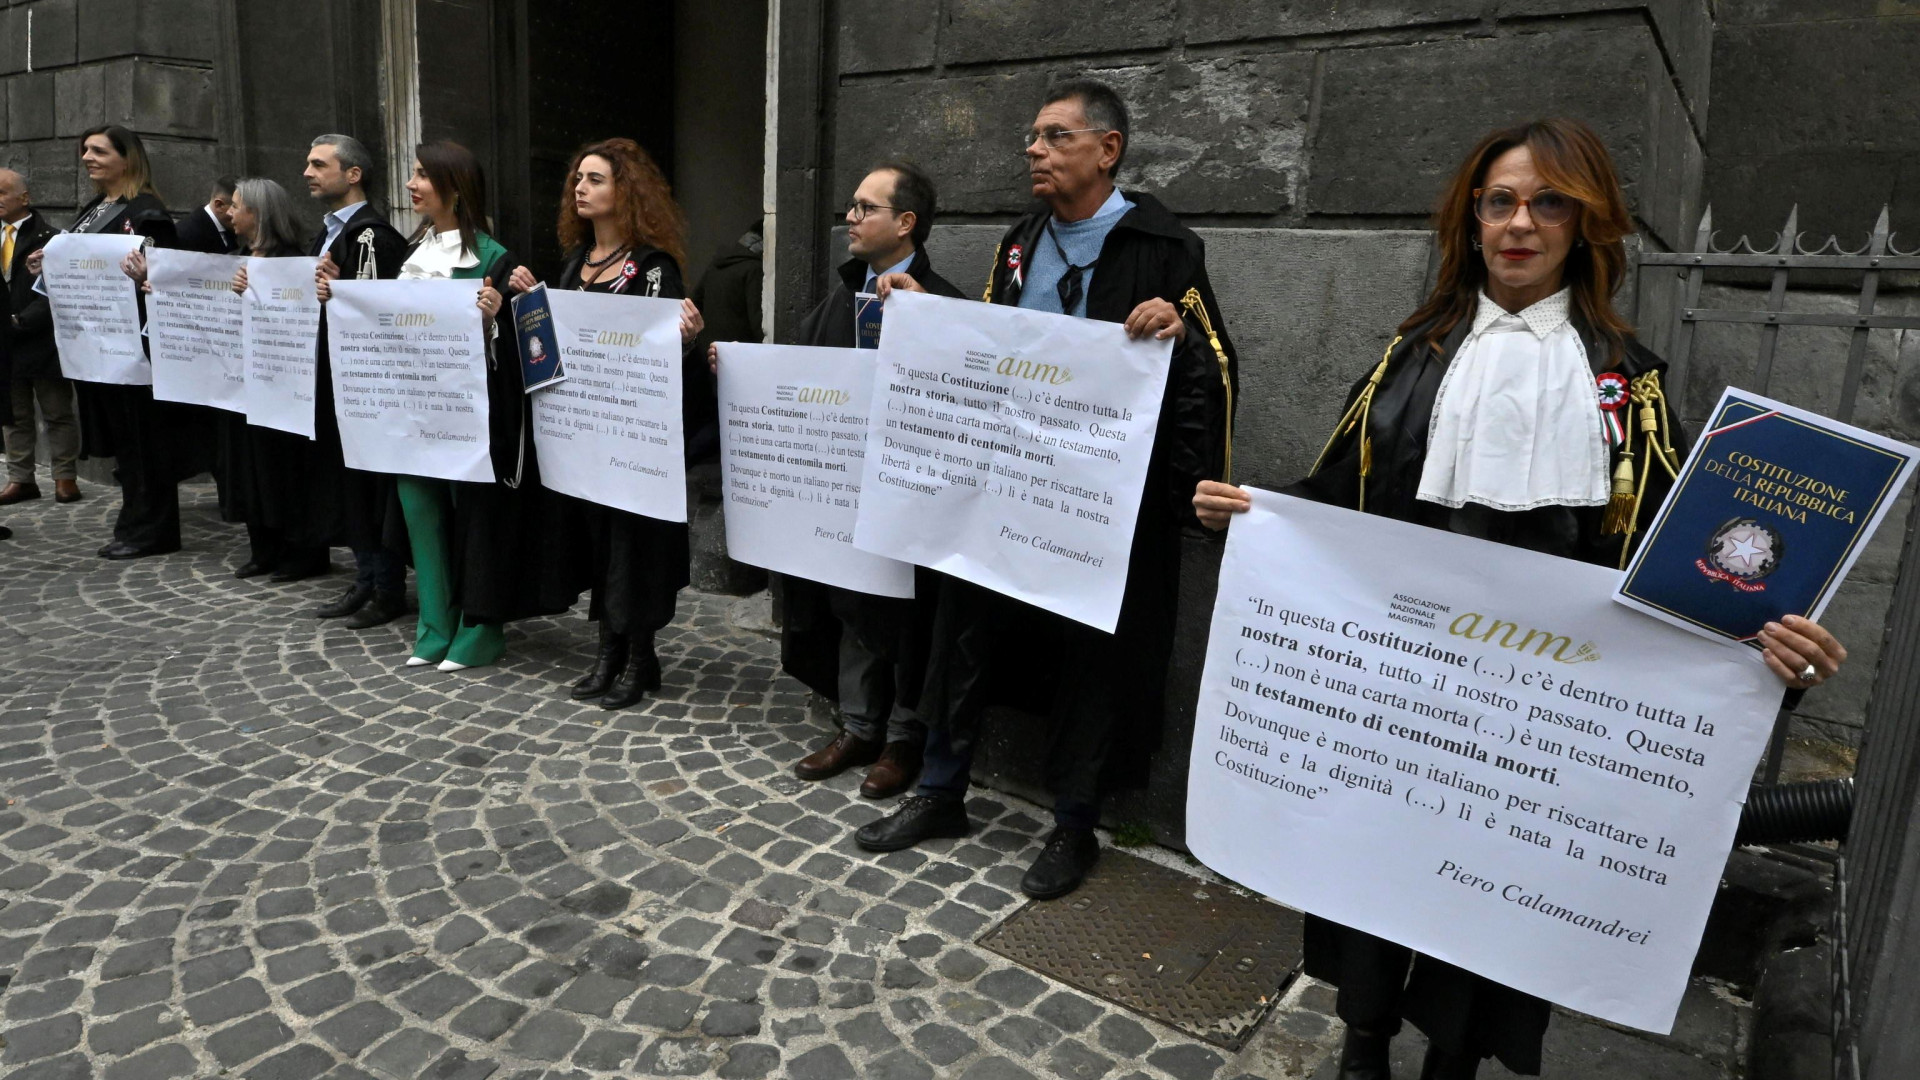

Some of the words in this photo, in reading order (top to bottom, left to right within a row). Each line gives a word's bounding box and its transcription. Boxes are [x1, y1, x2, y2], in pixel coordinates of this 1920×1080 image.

[349, 370, 384, 379] testamento
[566, 346, 606, 360] Costituzione
[996, 357, 1059, 385] anm
[587, 393, 619, 405] centomila
[738, 405, 760, 416] questa
[761, 405, 808, 420] Costituzione
[839, 412, 864, 426] dentro
[798, 387, 841, 406] anm
[889, 383, 921, 397] nostra
[925, 390, 959, 405] storia,
[962, 396, 988, 411] tutto
[992, 400, 1001, 413] il
[1004, 406, 1036, 421] nostro
[1039, 415, 1082, 432] passato.
[1088, 422, 1127, 442] Questa
[907, 368, 939, 382] questa
[941, 372, 1010, 396] Costituzione
[1053, 395, 1090, 413] dentro
[1092, 404, 1119, 420] tutta
[1121, 407, 1133, 422] la
[728, 419, 749, 429] nostra
[777, 424, 795, 434] tutto
[805, 428, 829, 438] nostro
[886, 418, 898, 429] un
[900, 420, 955, 441] testamento
[957, 432, 969, 445] di
[970, 438, 1022, 458] centomila
[1024, 450, 1056, 467] morti.
[908, 405, 926, 417] non
[927, 406, 934, 419] è
[935, 411, 954, 423] una
[955, 415, 981, 429] carta
[982, 421, 1011, 436] morta
[1034, 434, 1042, 444] è
[1043, 436, 1057, 447] un
[1059, 438, 1121, 463] testamento,
[609, 456, 628, 469] Piero
[730, 463, 762, 479] Dovunque
[769, 472, 791, 482] morto
[738, 449, 776, 462] testamento
[777, 453, 785, 463] di
[786, 457, 823, 469] centomila
[884, 436, 932, 458] Dovunque
[934, 448, 941, 460] è
[943, 453, 973, 468] morto
[976, 461, 990, 472] un
[992, 461, 1028, 482] italiano
[1030, 475, 1048, 488] per
[1050, 478, 1100, 502] riscattare
[1102, 491, 1113, 506] la
[1728, 451, 1850, 503] COSTITUZIONE
[881, 453, 911, 471] libertà
[915, 465, 922, 474] e
[927, 464, 936, 478] la
[941, 469, 977, 487] dignità
[1032, 495, 1054, 510] nata
[1060, 500, 1070, 514] la
[1076, 508, 1110, 526] nostra
[1704, 459, 1750, 486] DELLA
[1754, 478, 1855, 524] REPUBBLICA
[1733, 487, 1807, 524] ITALIANA
[814, 526, 835, 540] Piero
[999, 525, 1029, 544] Piero
[1031, 535, 1104, 568] Calamandrei
[1392, 593, 1451, 614] ASSOCIAZIONE
[1732, 579, 1765, 591] ITALIANA
[1387, 611, 1436, 629] MAGISTRATI
[1390, 602, 1435, 620] NAZIONALE
[1448, 612, 1572, 663] anm
[1279, 609, 1335, 633] questa
[1341, 621, 1468, 668] Costituzione
[1559, 679, 1629, 712] dentro
[1635, 701, 1686, 729] tutta
[1694, 715, 1715, 737] la
[1241, 626, 1298, 652] nostra
[1307, 644, 1367, 672] storia,
[1379, 661, 1422, 685] tutto
[1432, 673, 1447, 692] il
[1455, 684, 1519, 712] nostro
[1526, 705, 1612, 740] passato.
[1626, 729, 1705, 767] Questa
[1230, 676, 1250, 692] un
[1255, 682, 1357, 724] testamento
[1362, 713, 1383, 732] di
[1387, 723, 1488, 763] centomila
[1494, 755, 1560, 787] morti.
[1273, 662, 1306, 682] non
[1310, 668, 1321, 685] è
[1325, 677, 1357, 696] una
[1361, 688, 1407, 710] carta
[1411, 701, 1469, 728] morta
[1520, 728, 1532, 746] è
[1537, 737, 1563, 756] un
[1568, 745, 1694, 798] testamento,
[1224, 700, 1310, 743] Dovunque
[1316, 731, 1327, 748] è
[1332, 740, 1388, 766] morto
[1395, 758, 1419, 776] un
[1426, 763, 1500, 801] italiano
[1505, 794, 1542, 814] per
[1547, 805, 1649, 849] riscattare
[1656, 836, 1676, 858] la
[1219, 725, 1269, 757] libertà
[1279, 752, 1290, 764] e
[1301, 753, 1317, 773] la
[1328, 764, 1393, 796] dignità
[1458, 802, 1472, 821] lì
[1484, 812, 1496, 829] è
[1508, 824, 1552, 849] nata
[1566, 839, 1585, 860] la
[1599, 855, 1667, 886] nostra
[1436, 860, 1495, 893] Piero
[1501, 884, 1651, 945] Calamandrei
